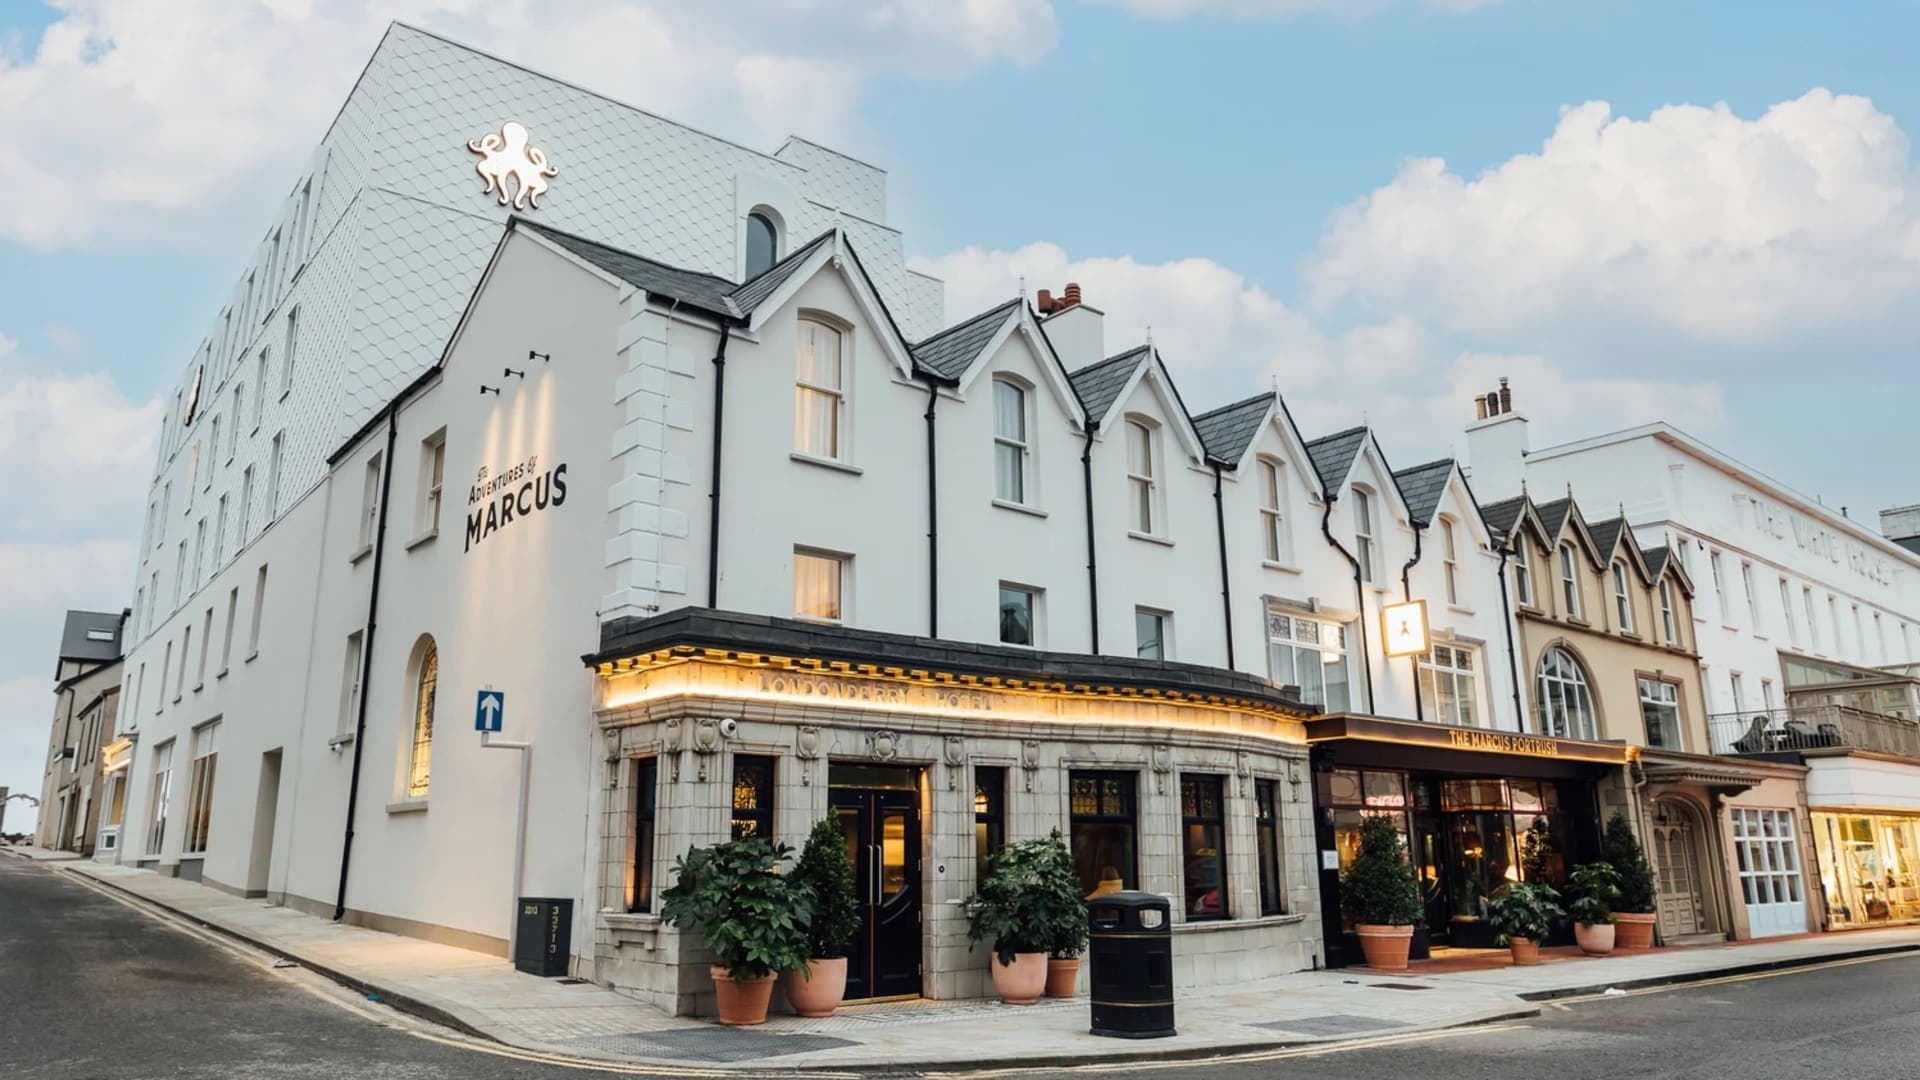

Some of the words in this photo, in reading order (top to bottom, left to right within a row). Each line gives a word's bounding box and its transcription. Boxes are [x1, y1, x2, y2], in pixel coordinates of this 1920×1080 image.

[464, 463, 567, 554] MARCUS
[759, 674, 910, 704] LONDONDERRY
[935, 690, 993, 711] HOTEL
[1448, 730, 1470, 746] THE
[1471, 733, 1511, 750] MARCUS
[1513, 737, 1558, 755] PORTRUSH
